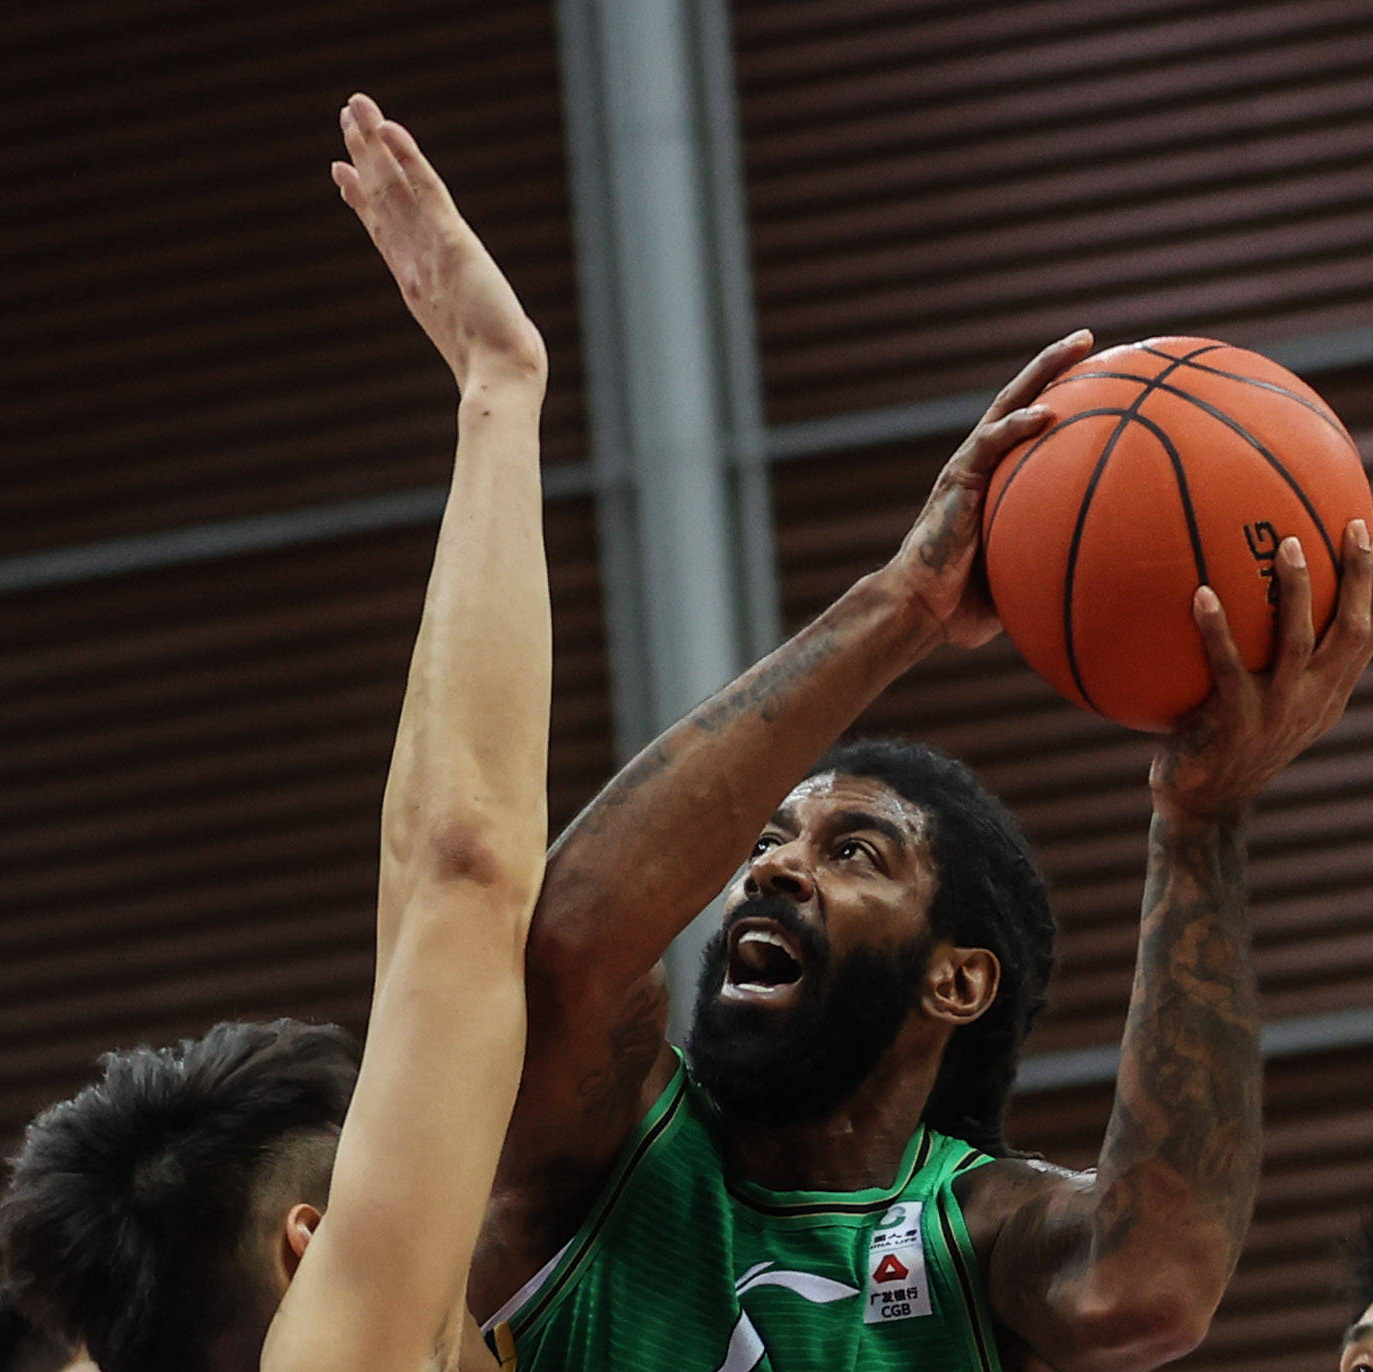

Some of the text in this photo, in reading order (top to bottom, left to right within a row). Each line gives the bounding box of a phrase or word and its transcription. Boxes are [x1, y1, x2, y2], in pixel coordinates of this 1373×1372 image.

[870, 1287, 918, 1305] 广发银行
[881, 1303, 912, 1318] CGB
